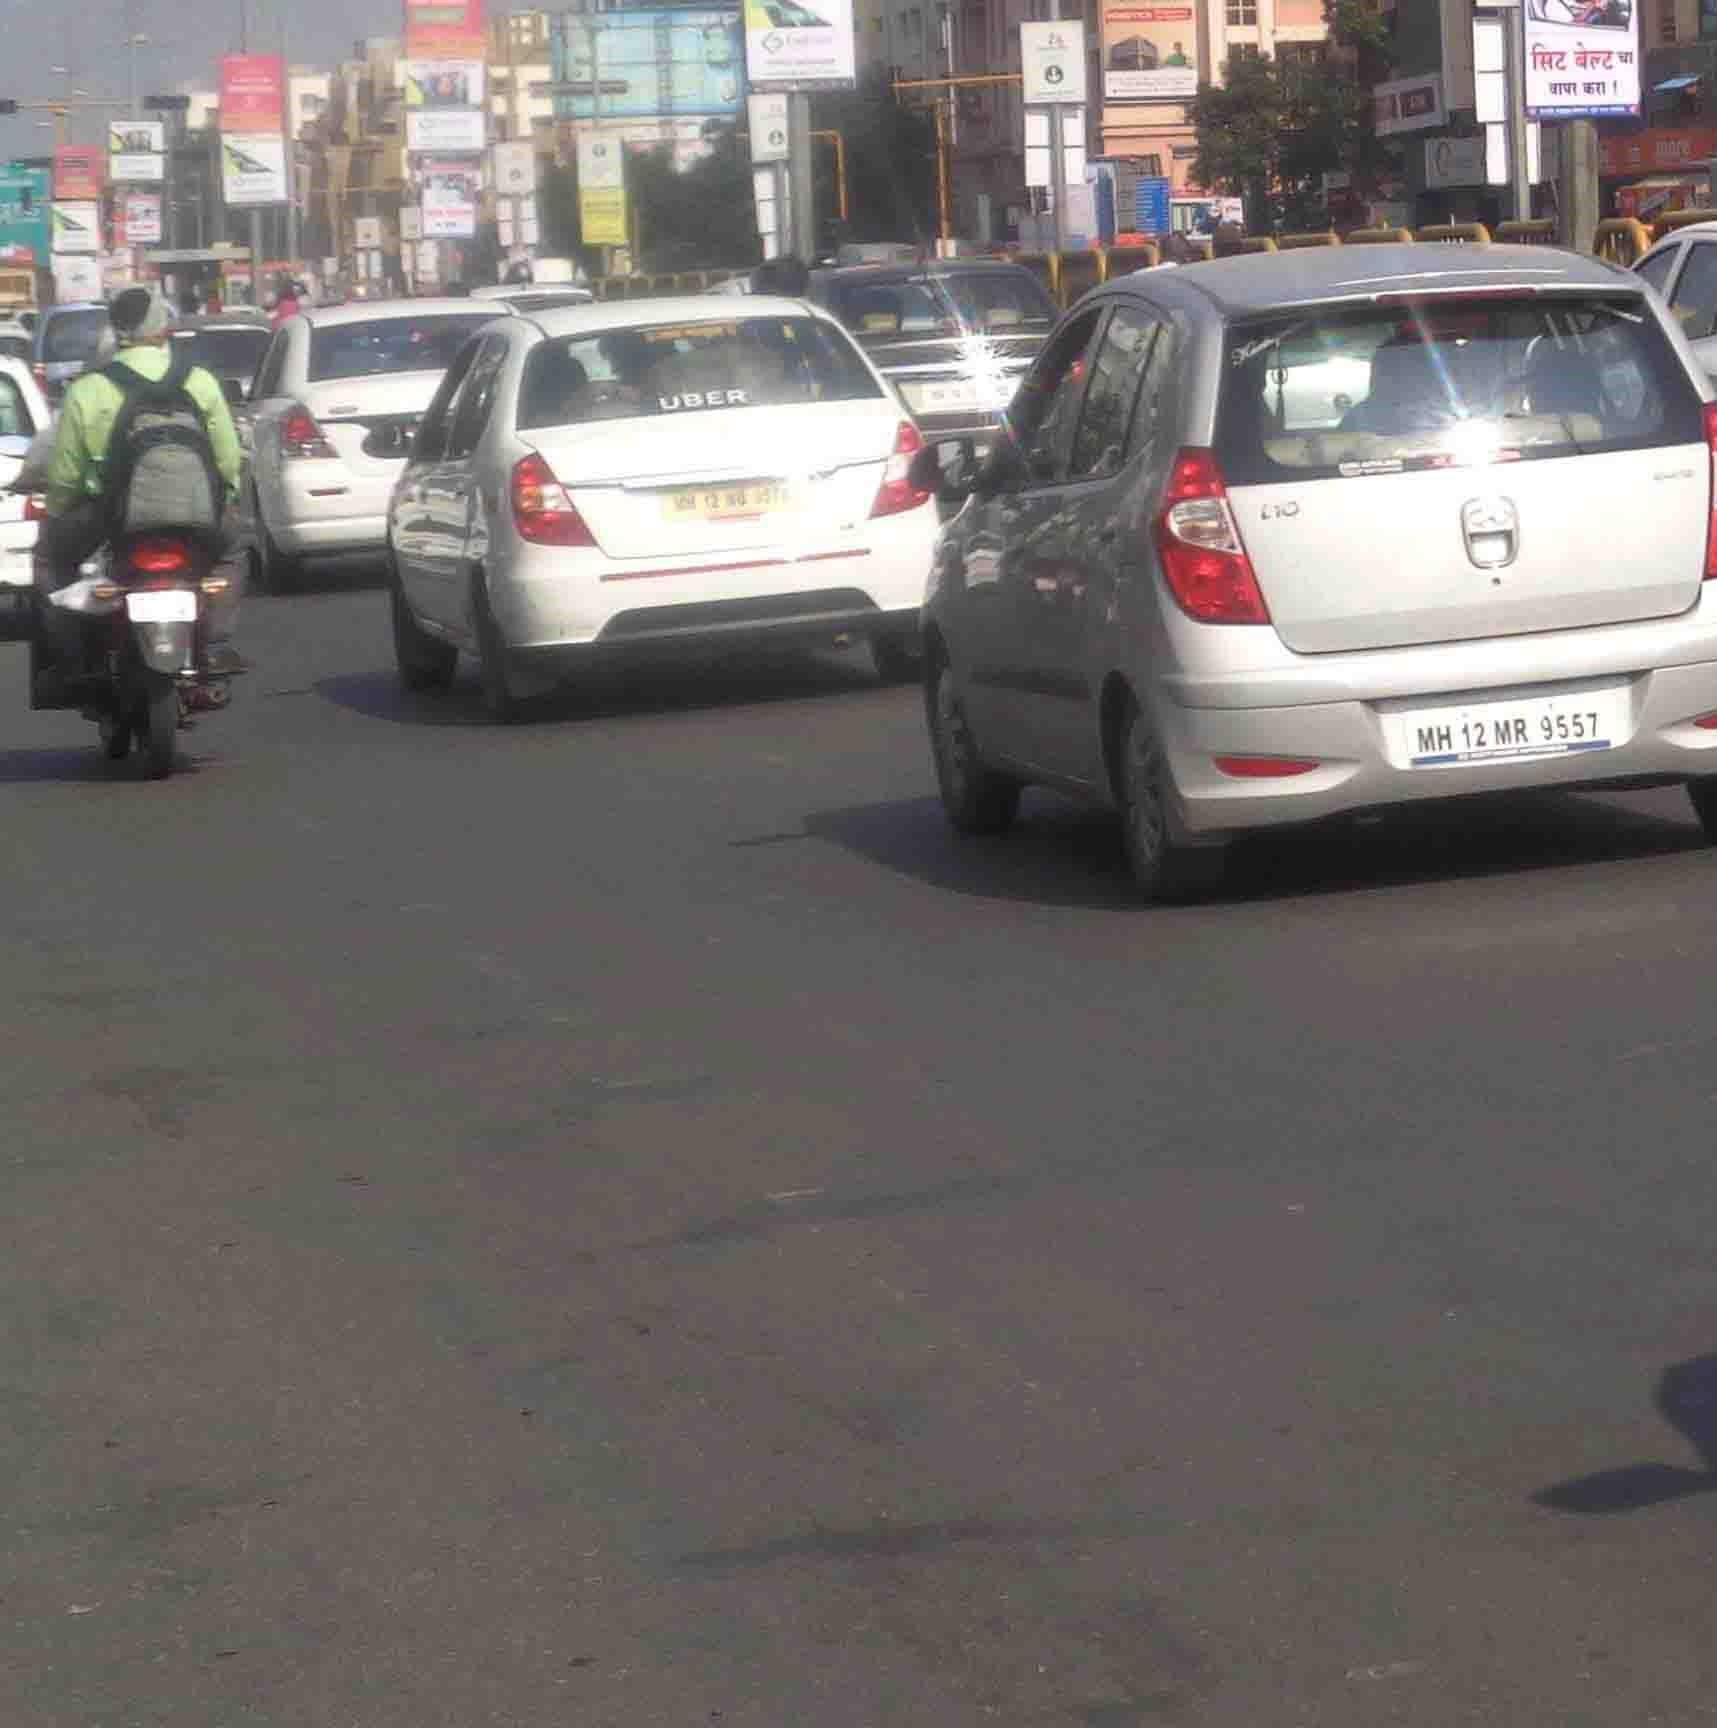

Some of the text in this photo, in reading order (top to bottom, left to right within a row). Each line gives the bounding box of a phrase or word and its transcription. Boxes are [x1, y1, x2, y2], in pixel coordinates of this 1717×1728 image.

[1530, 42, 1568, 71] सिट
[1574, 41, 1614, 71] बेल्ट
[1549, 81, 1578, 97] वापर
[1582, 81, 1607, 97] करा
[657, 388, 750, 410] UBER
[1417, 724, 1453, 753] MH
[1461, 721, 1487, 749] 12
[1493, 717, 1530, 745] MR
[1540, 711, 1599, 741] 9557
